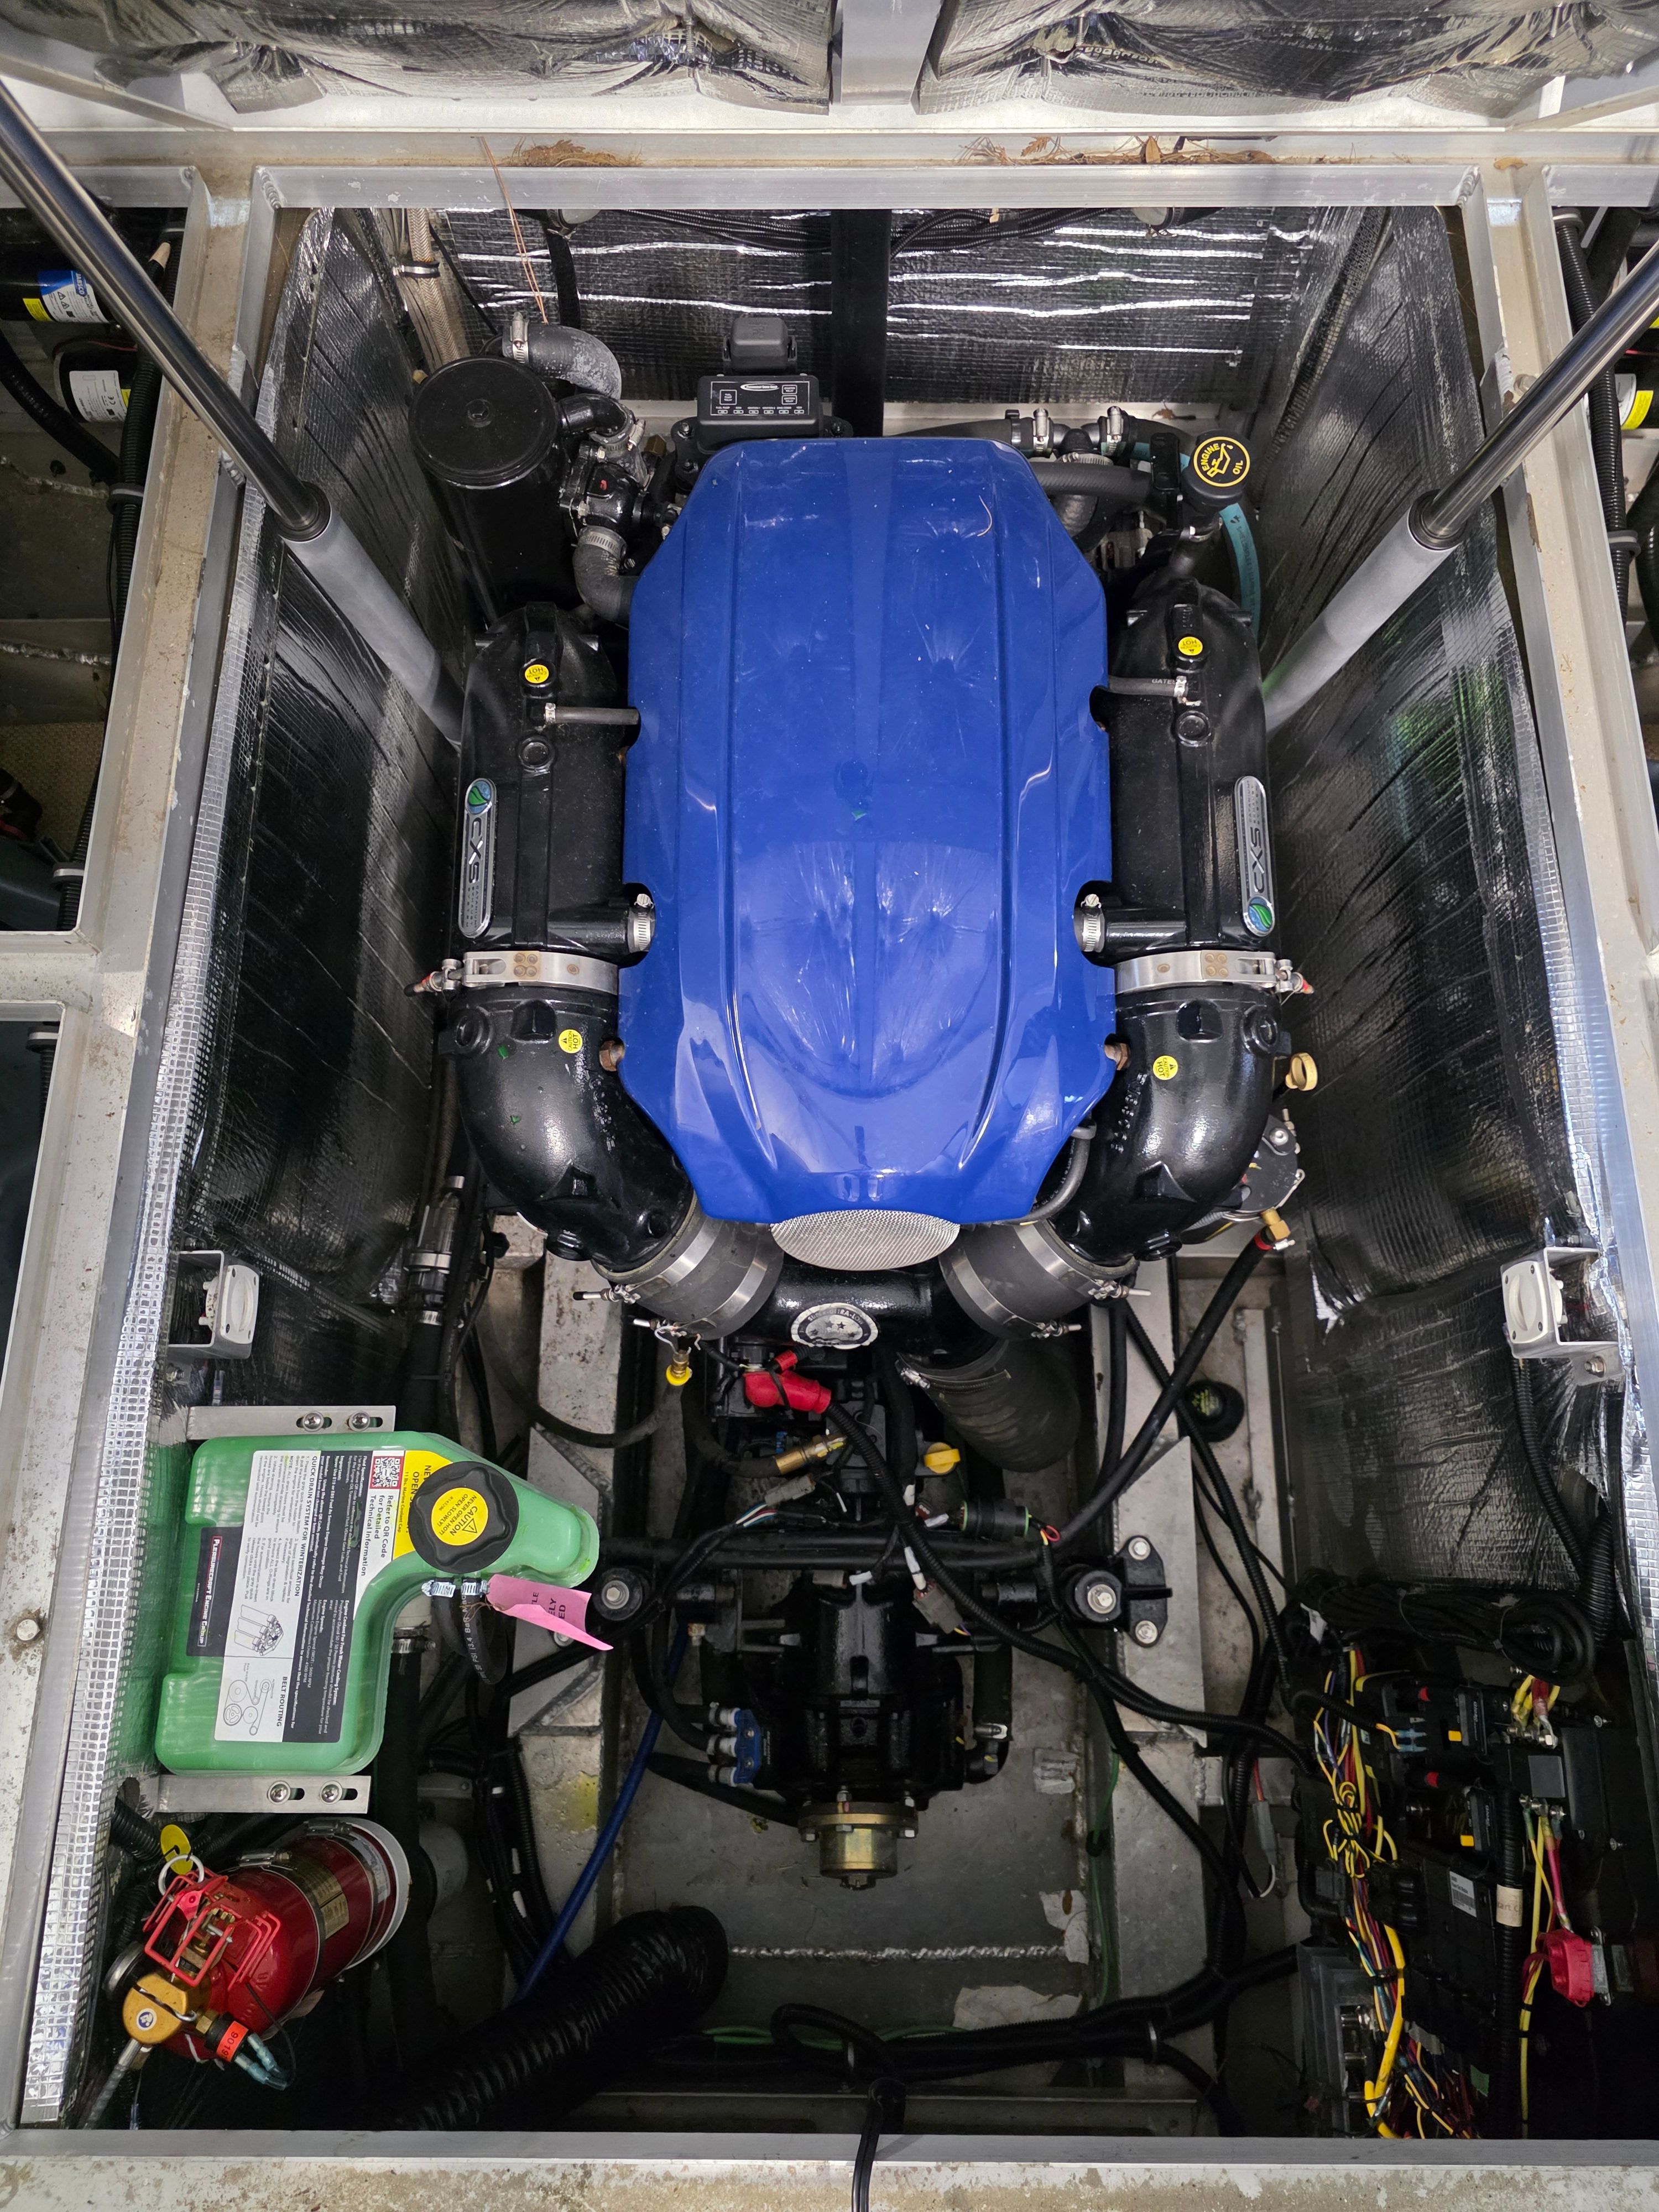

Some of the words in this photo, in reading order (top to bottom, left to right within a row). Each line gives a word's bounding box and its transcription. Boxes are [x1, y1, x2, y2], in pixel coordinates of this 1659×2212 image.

[76, 273, 85, 295] JABSCO
[1201, 443, 1220, 471] ENGINE
[1233, 460, 1244, 474] OIL
[469, 817, 483, 883] CXS
[1250, 827, 1265, 893] CXS
[1157, 1061, 1165, 1076] HOT
[410, 1471, 419, 1494] OPEN
[367, 1495, 375, 1529] Technical
[456, 1494, 468, 1507] OPEN
[462, 1495, 477, 1511] NEVER
[374, 1507, 383, 1538] Detailed
[437, 1506, 456, 1526] SLOWLY!
[450, 1510, 462, 1522] OPEN
[450, 1506, 477, 1536] CAUTION
[383, 1526, 389, 1537] QR
[439, 1523, 451, 1535] HOT!
[361, 1531, 371, 1575] Information
[206, 1538, 220, 1594] PLEASURECRAFT
[295, 1543, 305, 1597] WINTERIZATION
[202, 1595, 211, 1619] ENGINE
[199, 1621, 207, 1644] GROUP
[276, 1694, 285, 1726] ROUTING
